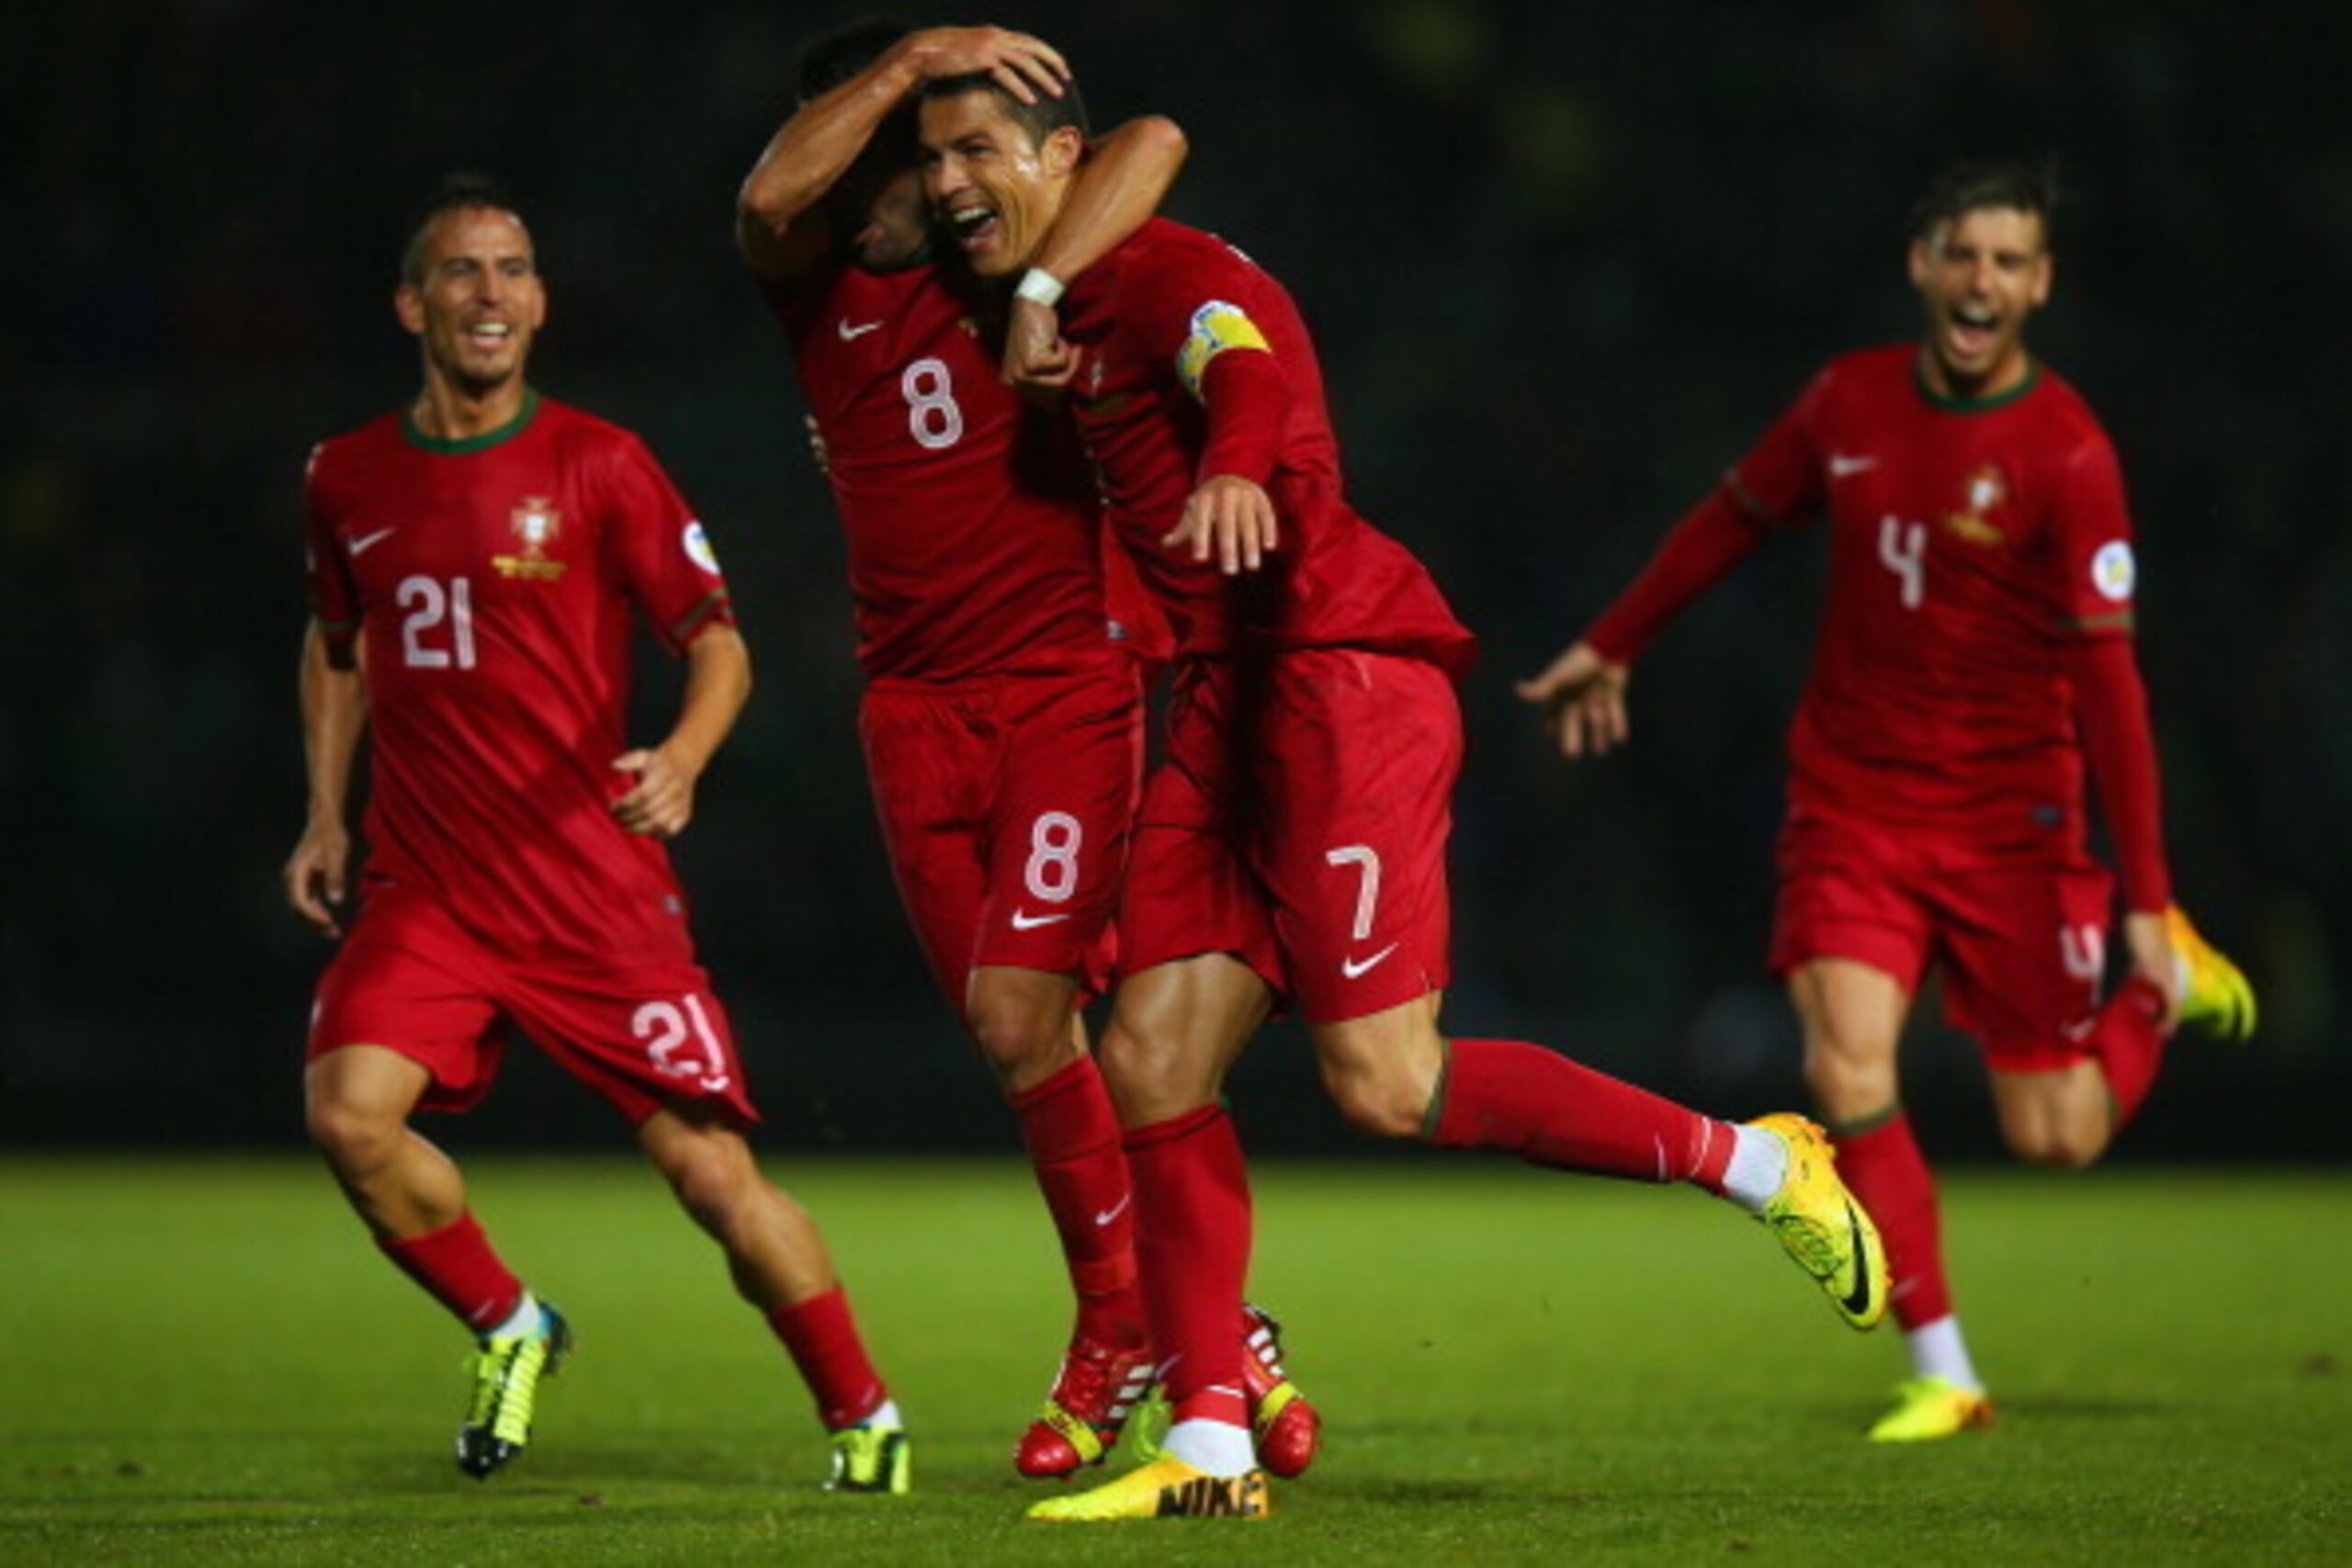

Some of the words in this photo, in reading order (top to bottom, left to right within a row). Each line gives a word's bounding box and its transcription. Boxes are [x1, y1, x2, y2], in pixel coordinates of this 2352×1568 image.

[902, 358, 963, 448] 8
[1880, 514, 1926, 609] 4
[396, 575, 475, 670] 21
[1024, 811, 1082, 902] 8
[1326, 845, 1380, 940] 7
[632, 993, 726, 1078] 21
[1157, 1472, 1263, 1518] NIKE
